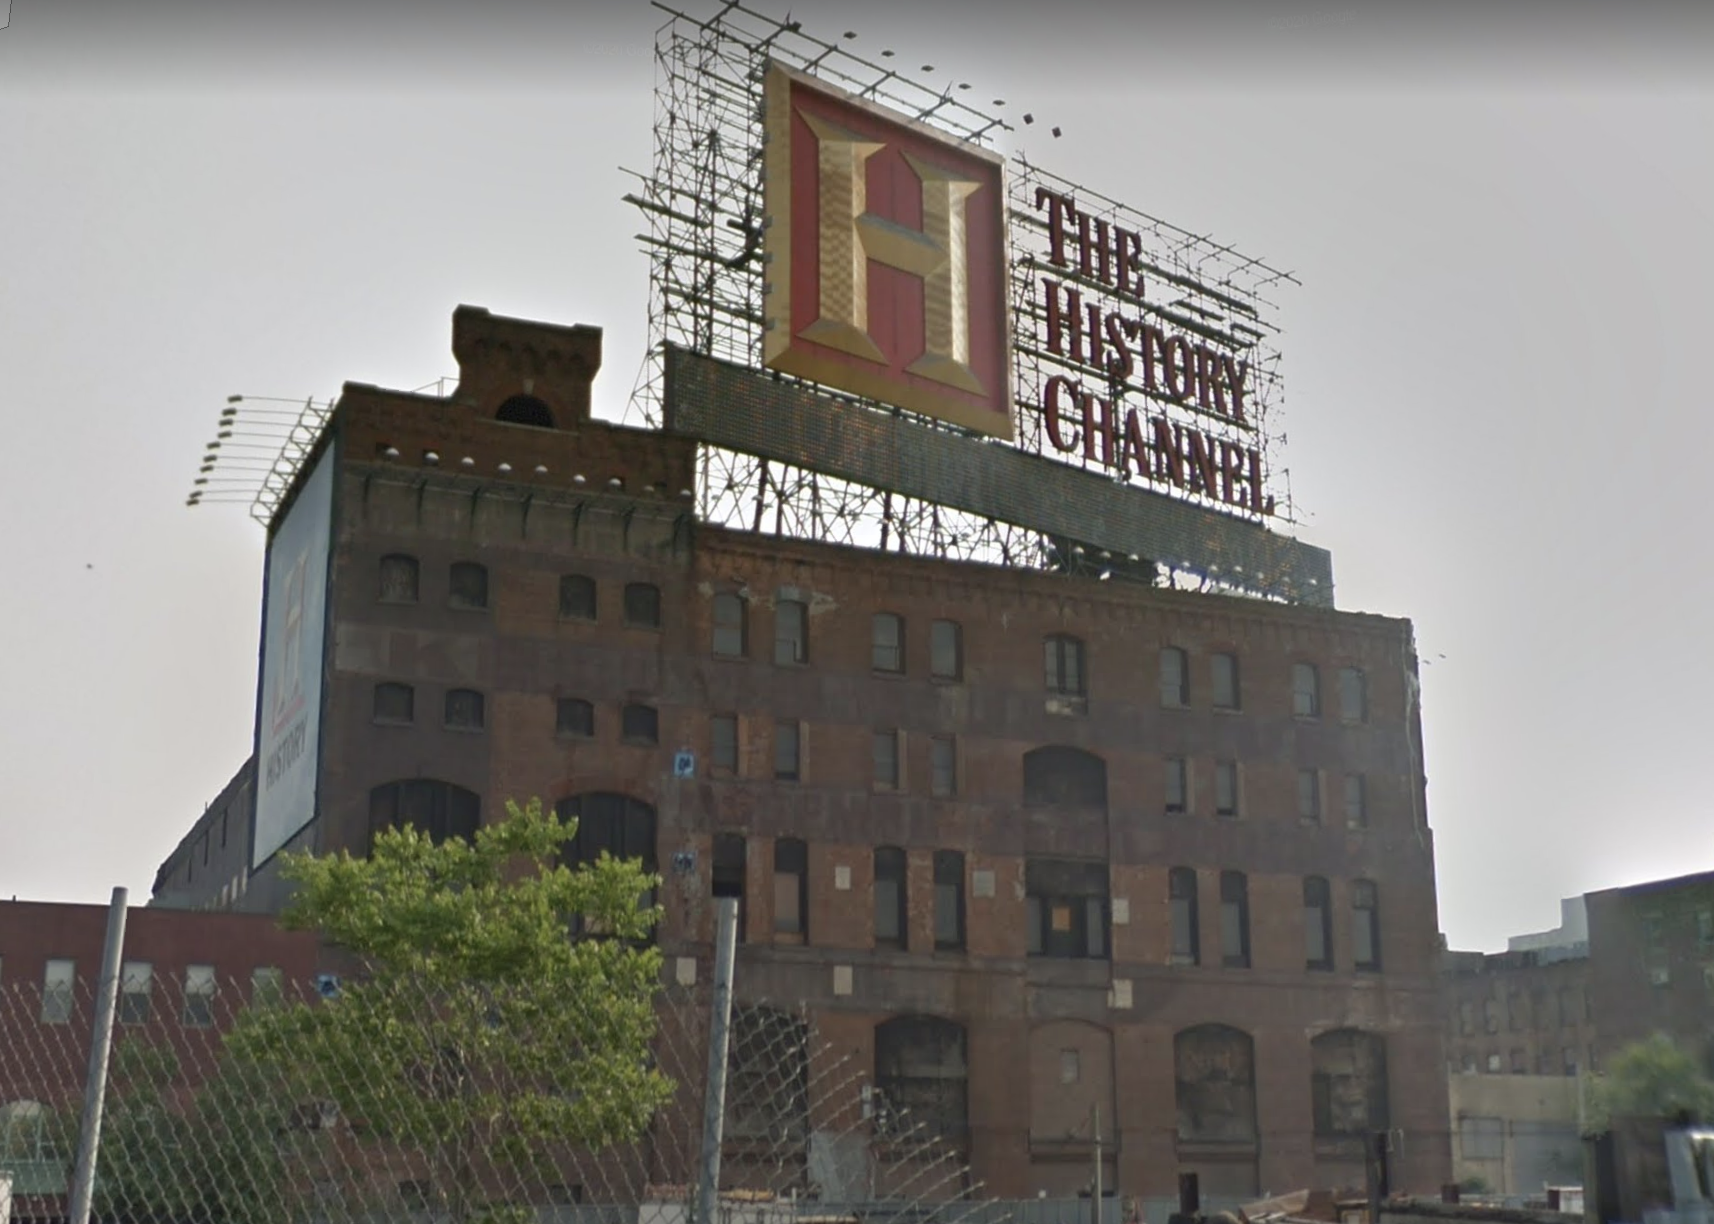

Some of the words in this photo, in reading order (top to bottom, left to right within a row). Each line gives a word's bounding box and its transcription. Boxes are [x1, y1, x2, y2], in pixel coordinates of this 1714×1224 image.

[794, 107, 990, 397] H
[1035, 186, 1145, 298] THE
[1041, 277, 1250, 422] HISTORY
[1044, 374, 1275, 516] CHANNEL
[265, 711, 308, 791] HISTORY
